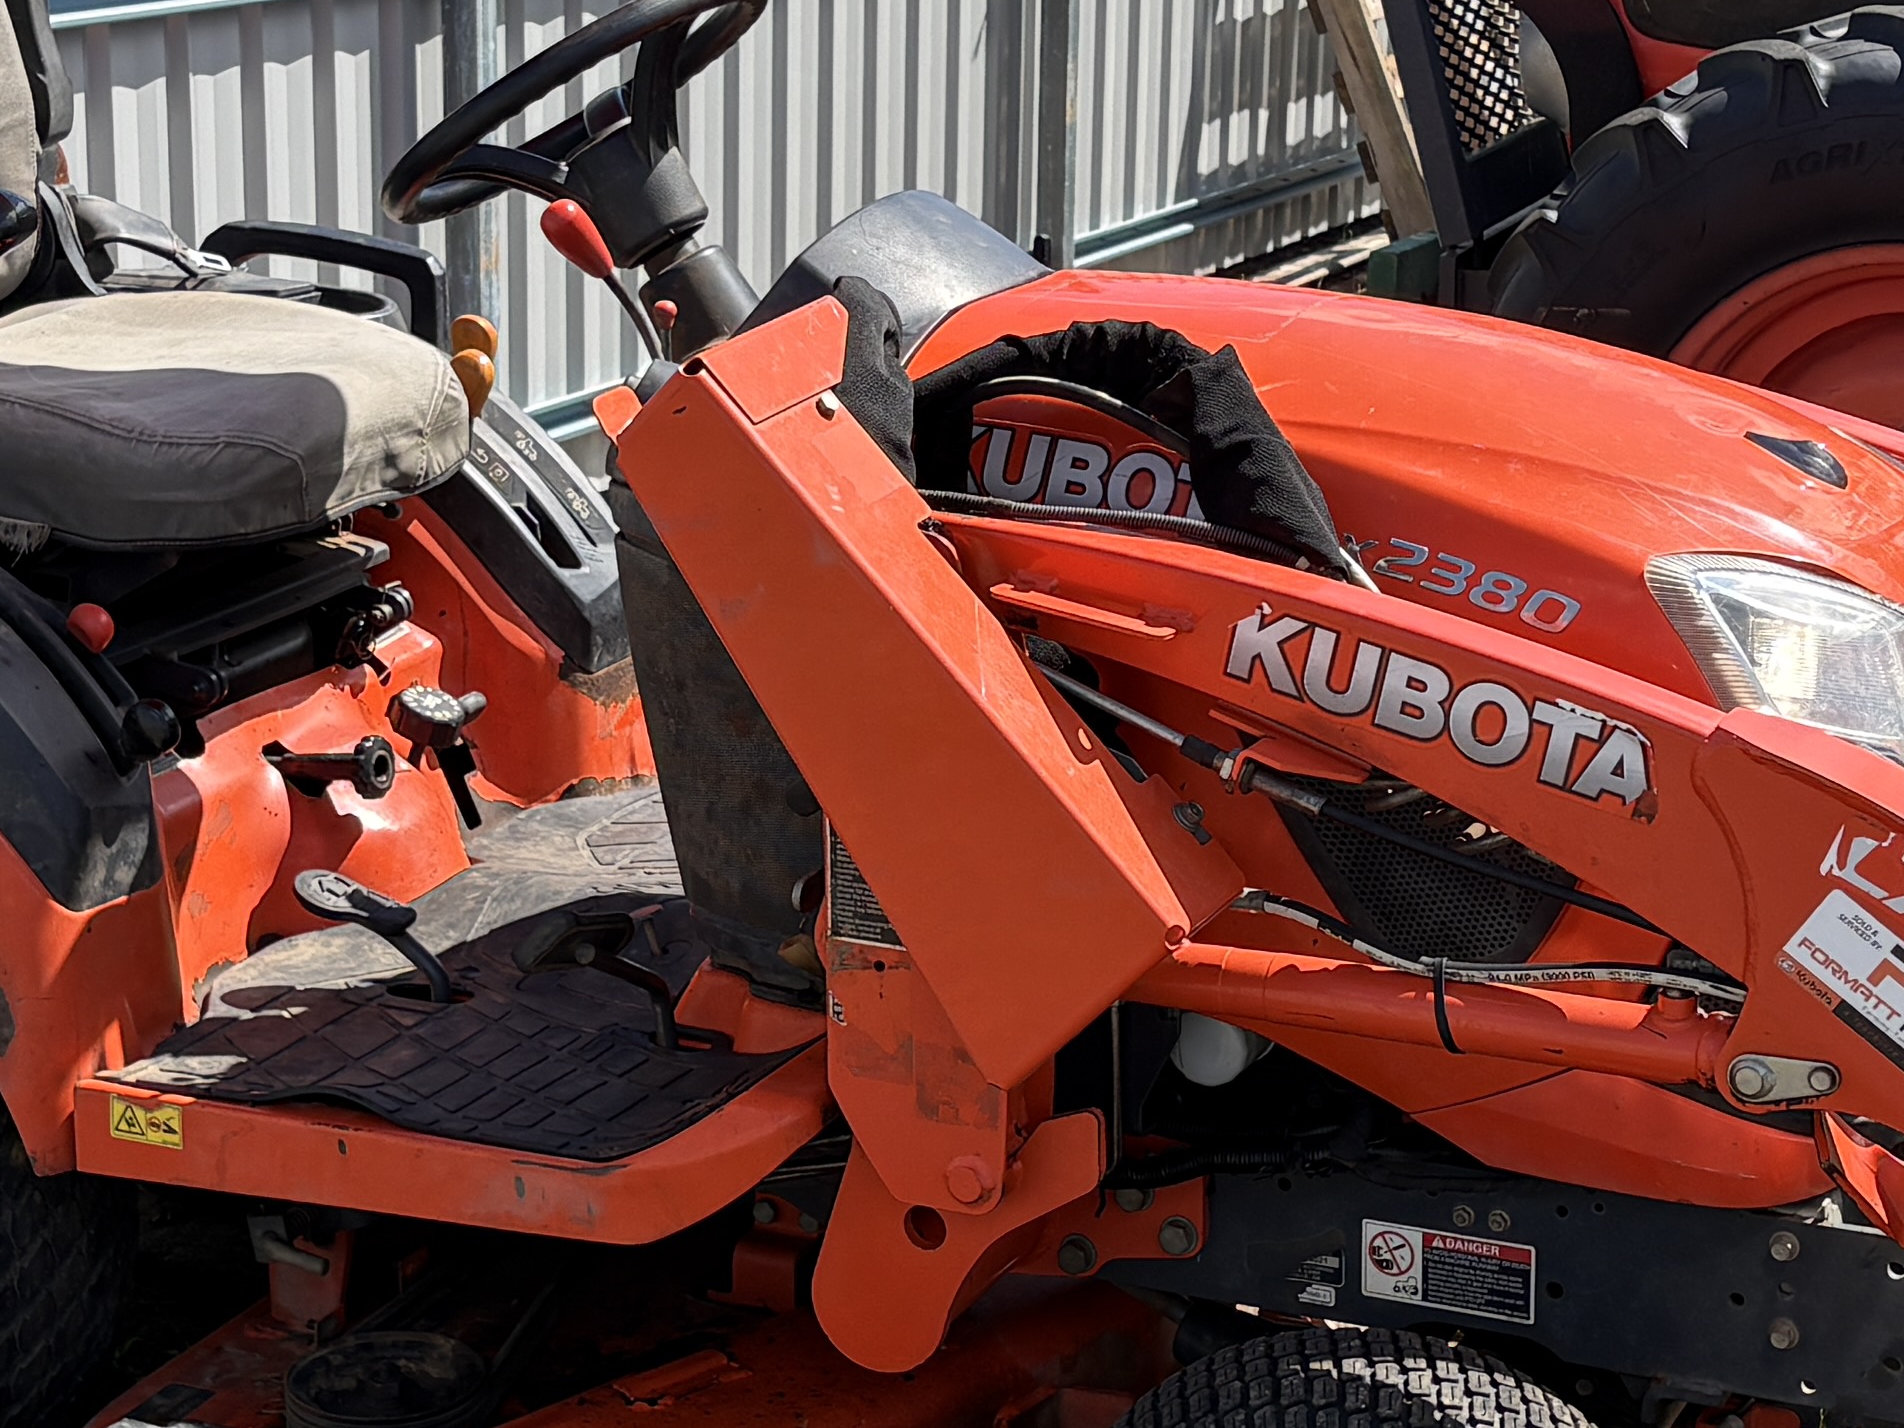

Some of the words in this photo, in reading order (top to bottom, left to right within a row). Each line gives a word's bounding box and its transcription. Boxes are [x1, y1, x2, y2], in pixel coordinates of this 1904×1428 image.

[1226, 608, 1652, 806] KUBOTA
[1797, 936, 1902, 1021] FORMATT
[1445, 1238, 1500, 1257] DANGER
